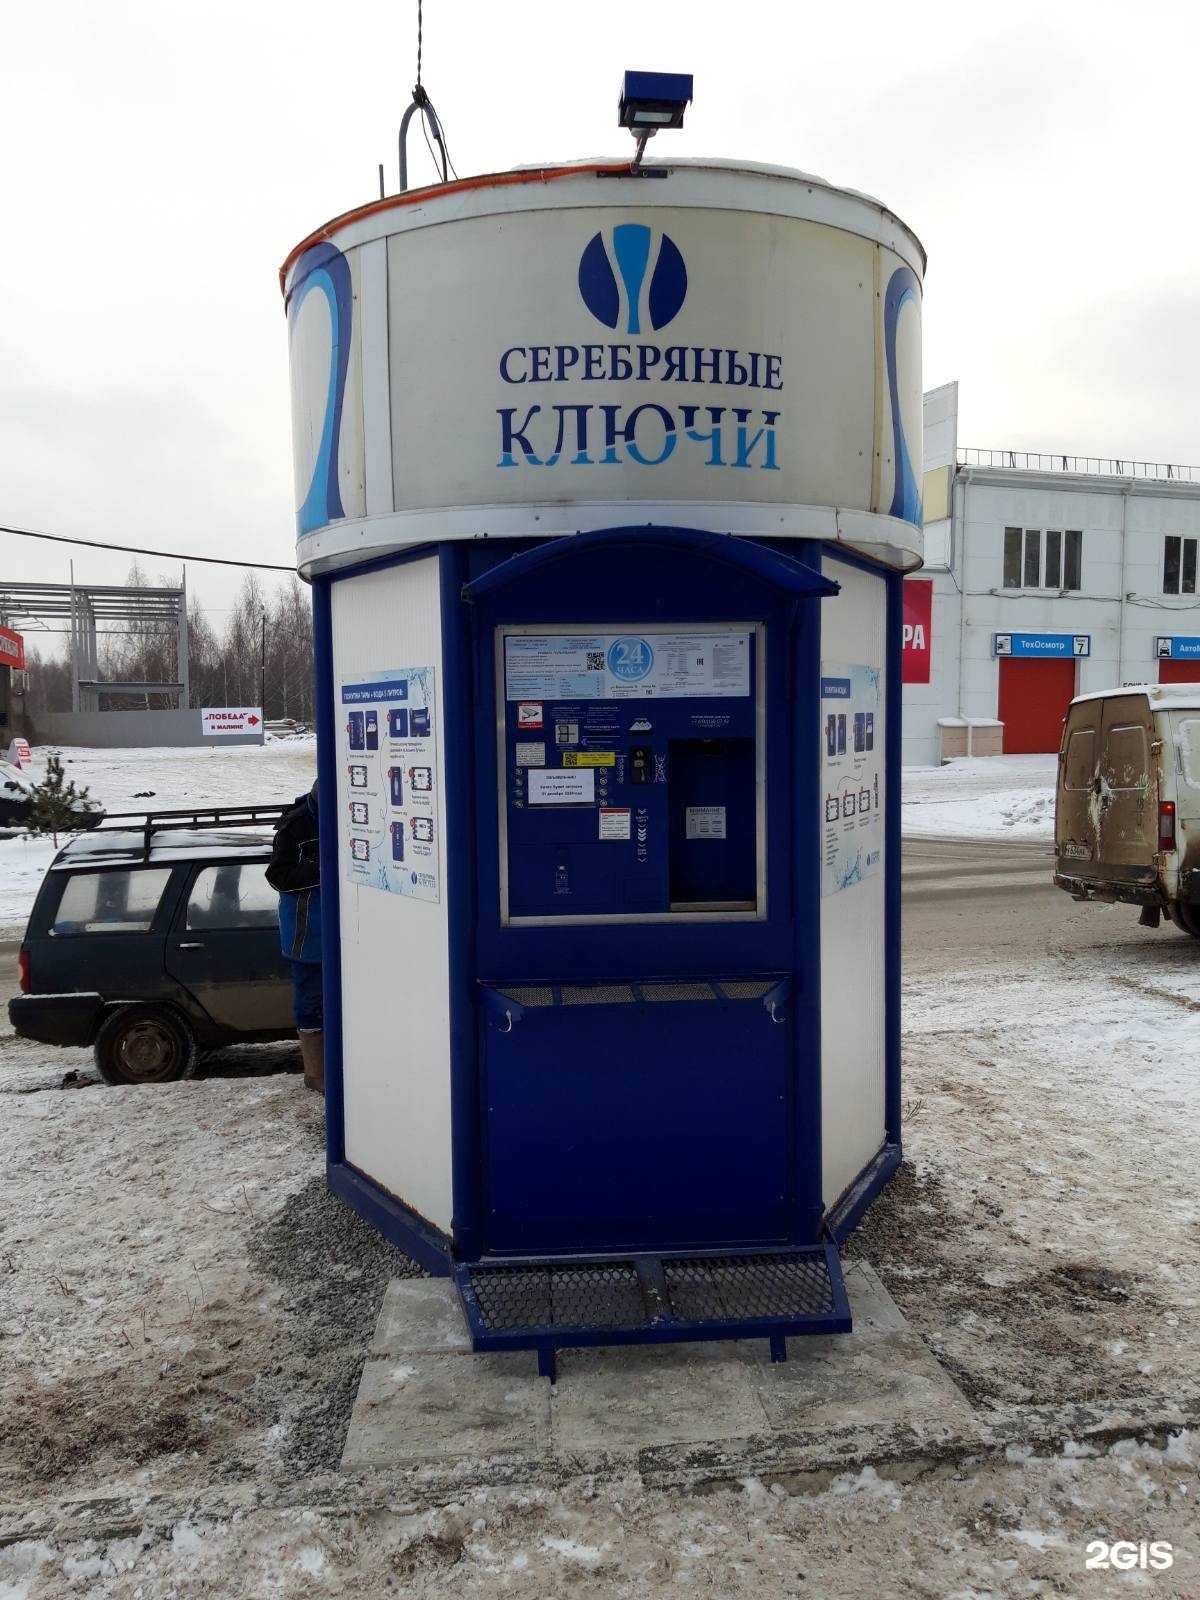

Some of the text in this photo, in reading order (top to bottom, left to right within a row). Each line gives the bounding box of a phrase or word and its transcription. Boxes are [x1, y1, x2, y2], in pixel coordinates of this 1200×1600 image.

[499, 344, 784, 390] СЕРЕБРЯНЫЕ
[496, 403, 781, 470] КЛЮЧИ
[616, 643, 644, 664] 24
[1021, 640, 1065, 650] ТехОсмотр
[1077, 643, 1084, 653] 7
